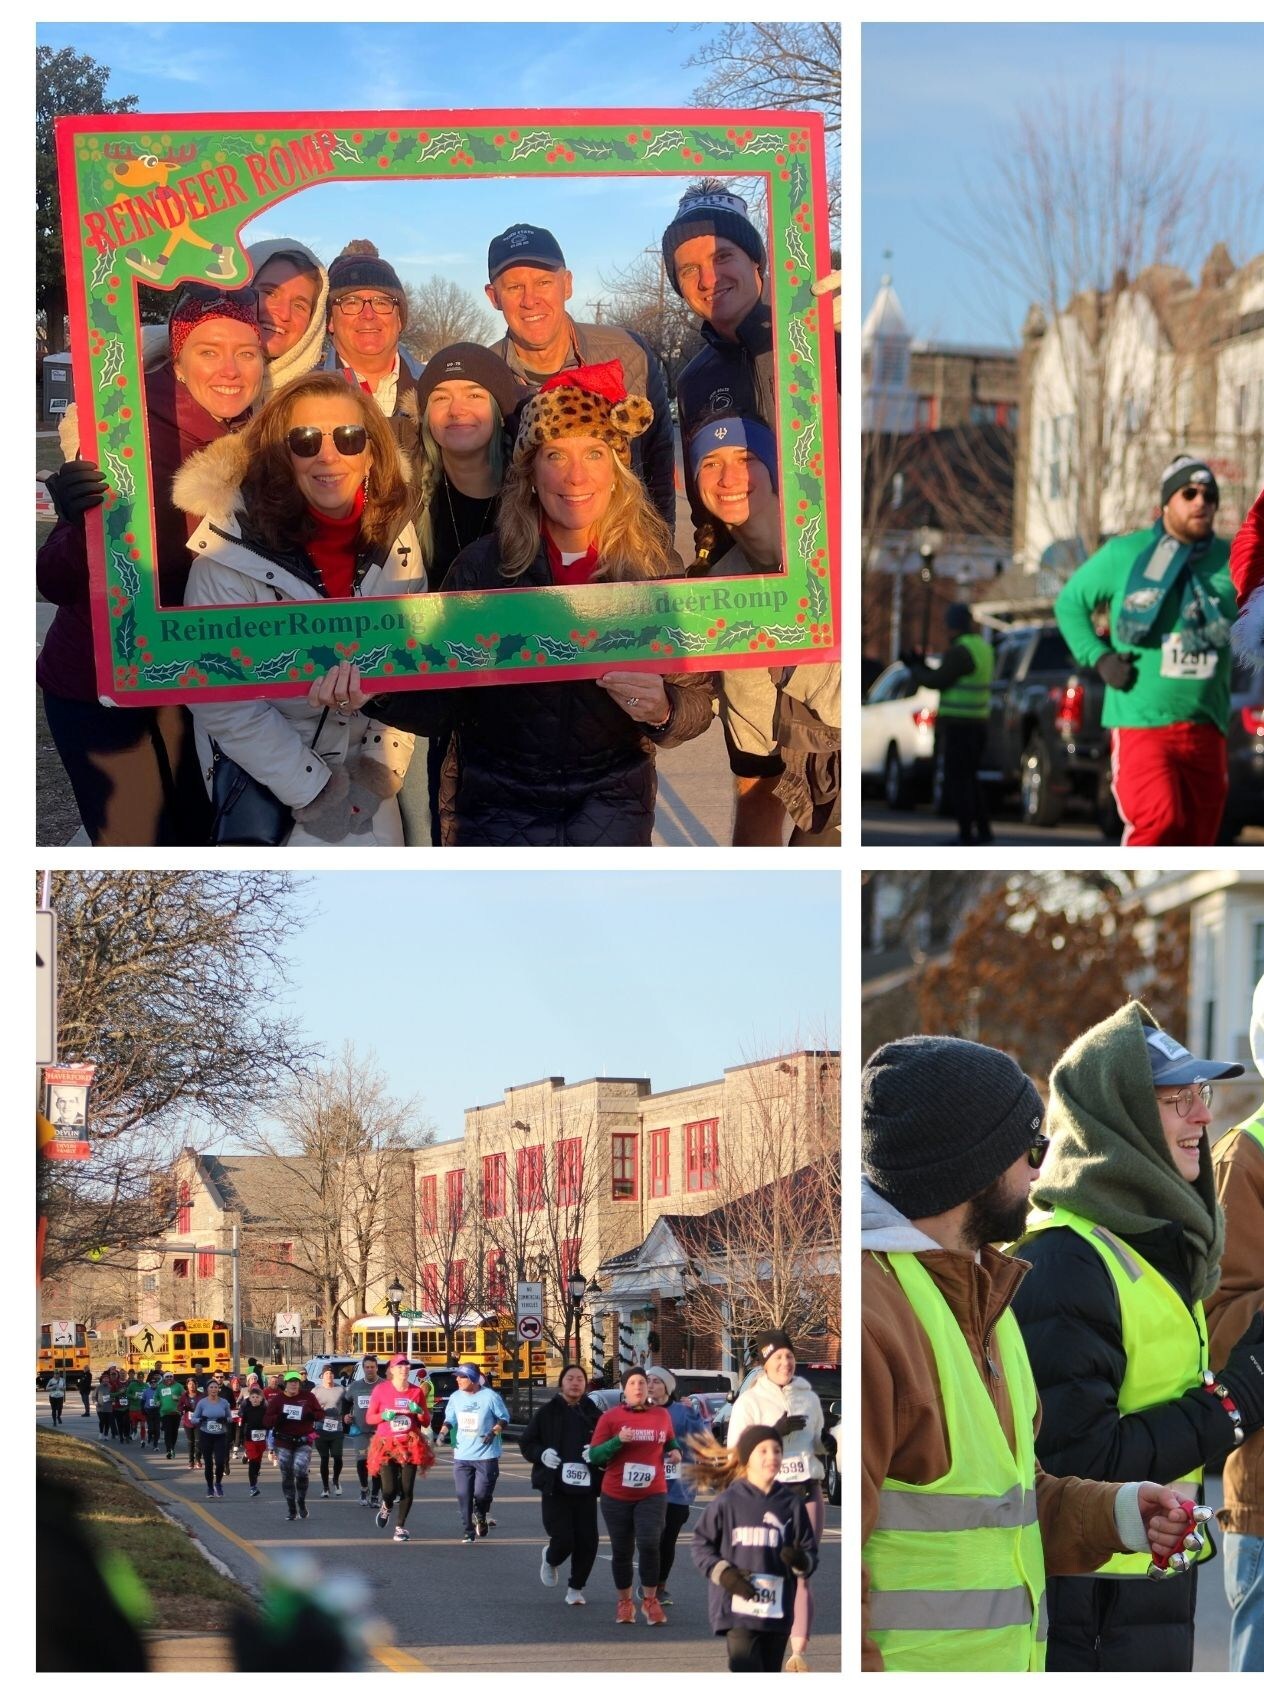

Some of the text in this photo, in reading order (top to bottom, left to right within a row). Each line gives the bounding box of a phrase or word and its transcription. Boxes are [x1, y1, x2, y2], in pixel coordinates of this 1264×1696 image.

[84, 129, 338, 255] REINDEER ROMP
[160, 611, 427, 643] ReindeerRomp.org
[566, 1469, 588, 1481] 3567
[627, 1471, 651, 1482] 1278
[748, 1588, 777, 1606] 594
